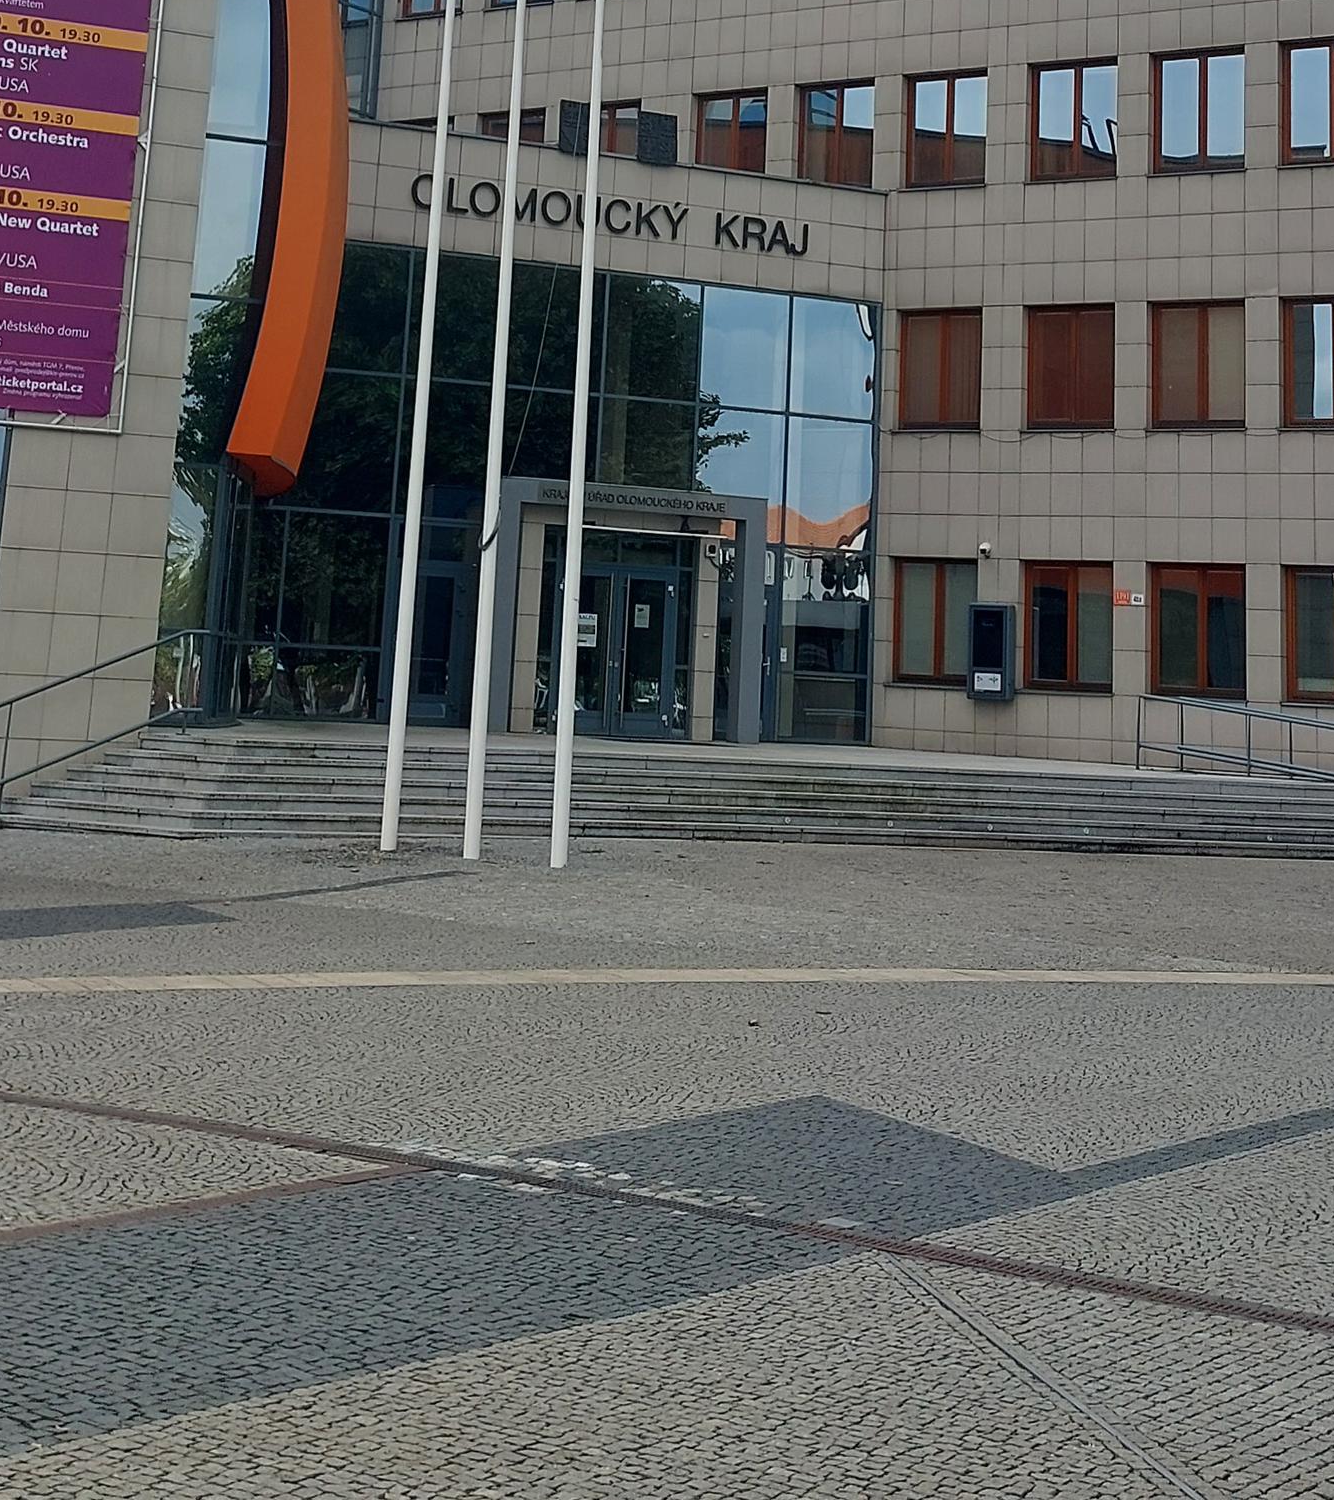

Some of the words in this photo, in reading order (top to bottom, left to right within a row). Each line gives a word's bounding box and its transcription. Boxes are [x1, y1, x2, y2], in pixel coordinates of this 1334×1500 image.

[18, 18, 51, 36] 10.
[60, 27, 101, 43] 19.30
[3, 39, 68, 60] Quartet
[19, 57, 39, 72] SK
[32, 110, 73, 125] 19.30
[8, 127, 89, 149] Orchestra
[0, 165, 30, 180] USA
[37, 197, 78, 213] 19.30
[410, 173, 689, 241] OLOMOUCKÝ
[715, 212, 809, 256] KRAJ
[36, 217, 99, 237] Quartet
[4, 282, 48, 298] Benda
[57, 325, 89, 338] domu
[696, 502, 726, 512] KRAJE
